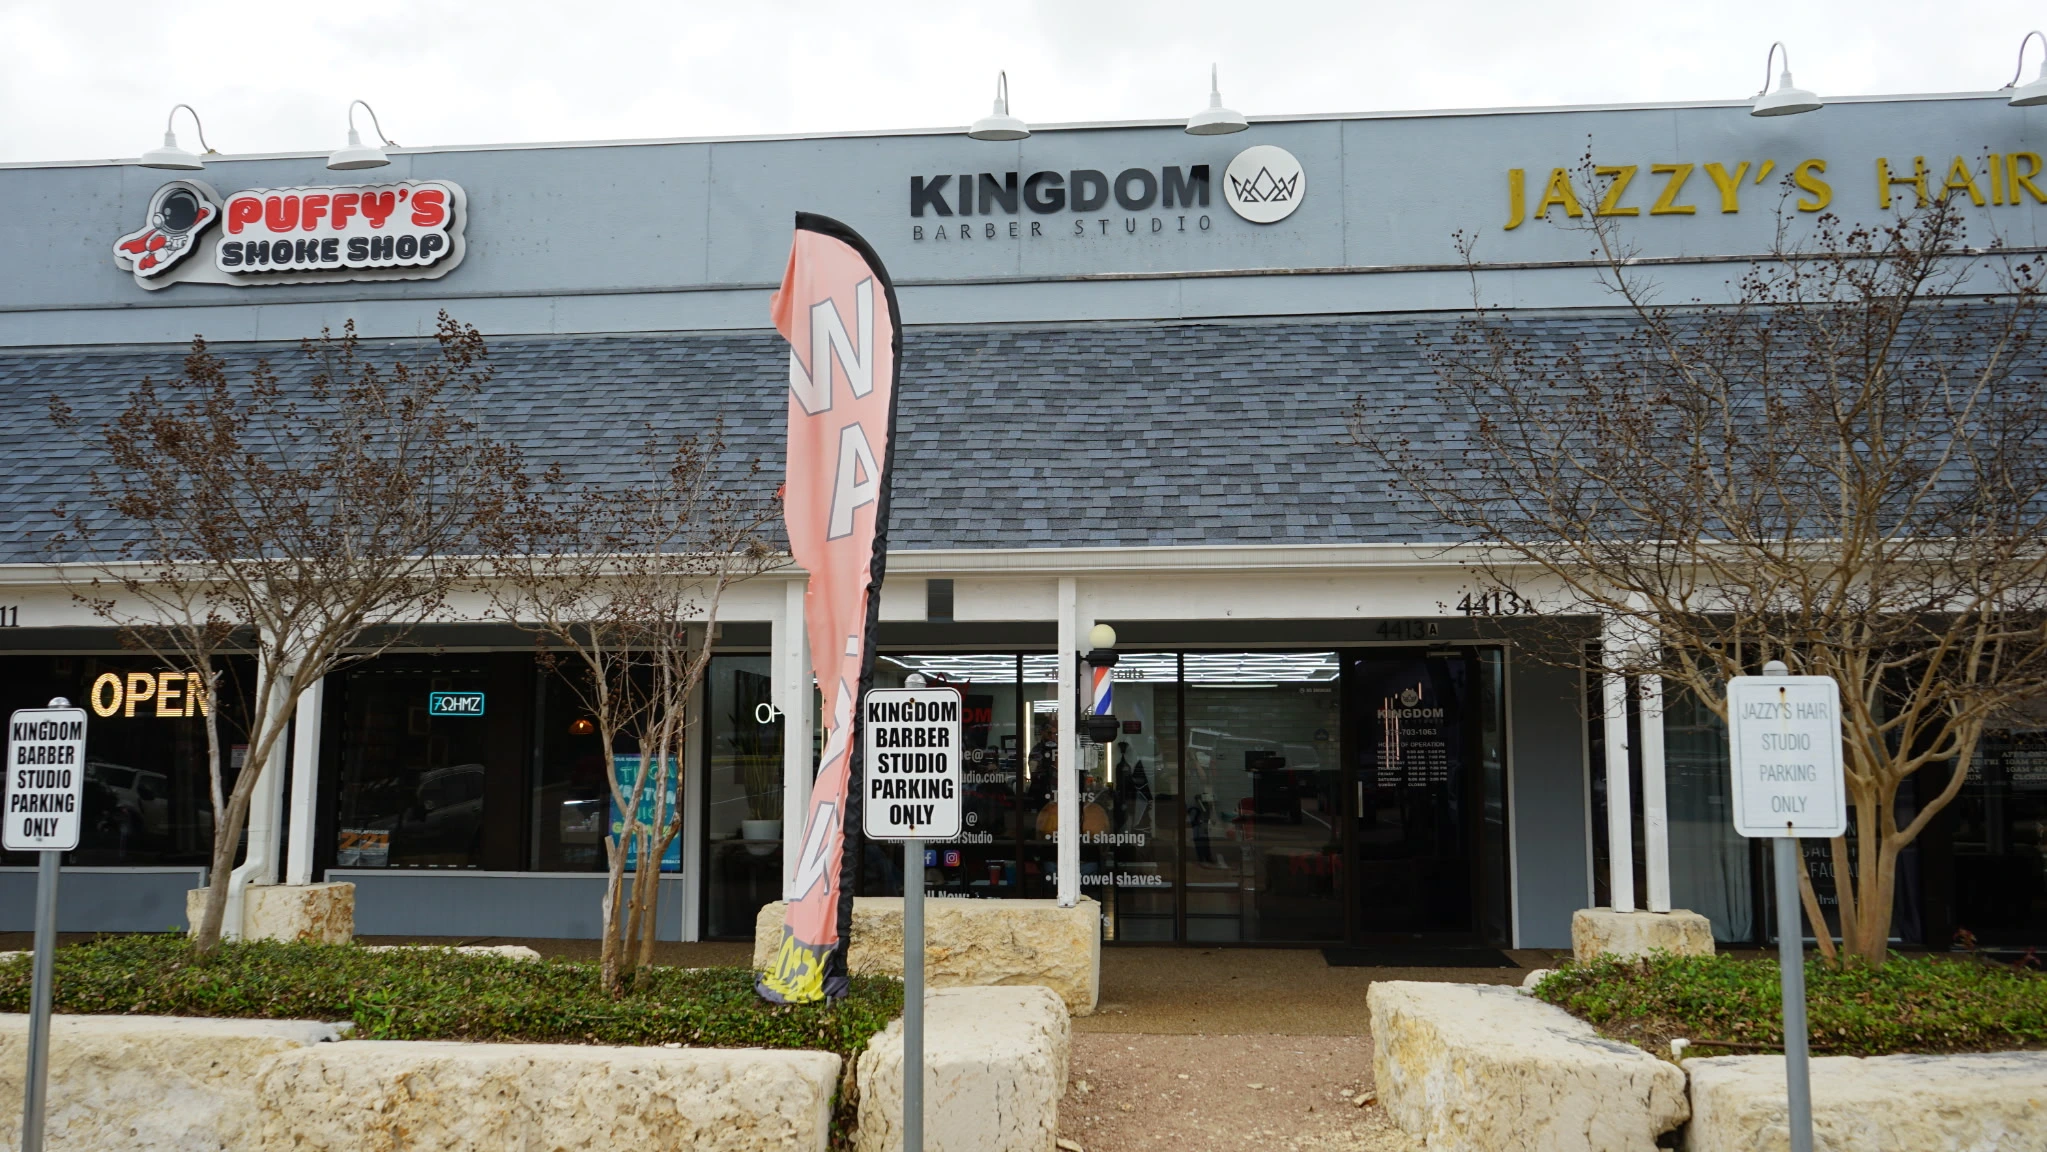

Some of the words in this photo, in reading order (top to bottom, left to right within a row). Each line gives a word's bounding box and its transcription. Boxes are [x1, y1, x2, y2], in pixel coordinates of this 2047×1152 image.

[910, 163, 1210, 217] KINGDOM
[1503, 158, 1833, 231] JAZZY'S
[1877, 151, 2047, 210] HAIR
[228, 189, 446, 234] PUFFY'S
[912, 221, 1042, 240] BARBER
[1074, 215, 1211, 236] STUDIO
[221, 237, 340, 267] SMOKE
[347, 233, 444, 262] SHOP
[91, 672, 214, 717] OPEN
[868, 701, 957, 723] KINGDOM
[1377, 708, 1444, 719] KINGDOM
[1742, 702, 1793, 720] JAZZY'S
[1797, 702, 1829, 720] HAIR
[13, 721, 83, 741] KINGDOM
[876, 727, 949, 748] BARBER
[1762, 733, 1811, 751] STUDIO
[17, 745, 75, 765] BARBER
[878, 752, 947, 774] STUDIO
[17, 769, 71, 789] STUDIO
[1760, 764, 1817, 782] PARKING
[871, 778, 954, 799] PARKING
[11, 793, 75, 813] PARKING
[1771, 795, 1808, 813] ONLY
[889, 804, 935, 825] ONLY
[23, 817, 59, 837] ONLY
[1093, 830, 1145, 847] shaping
[1116, 872, 1162, 886] shaves
